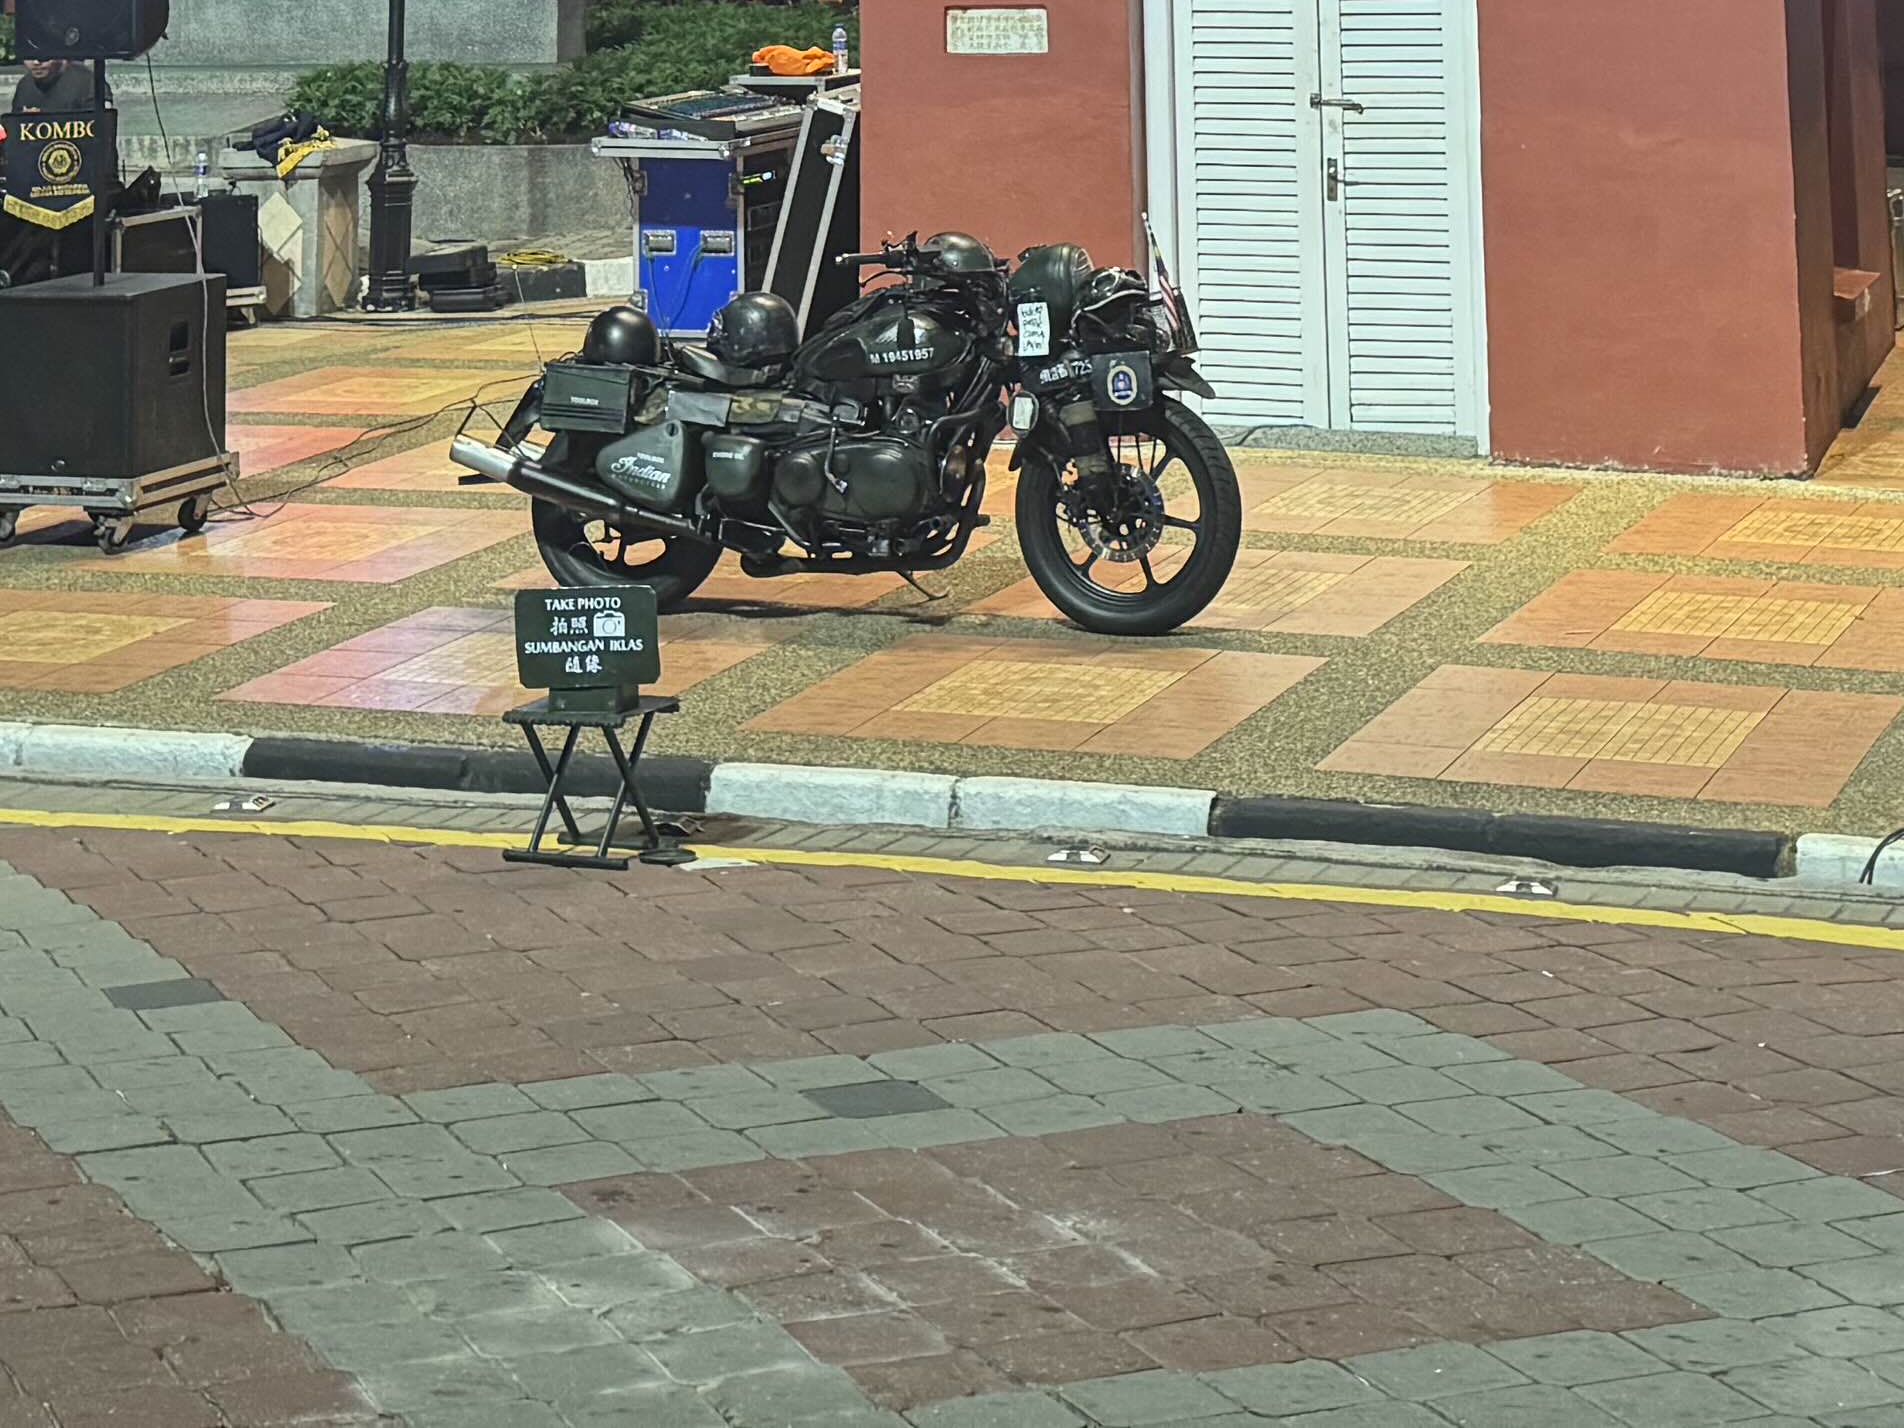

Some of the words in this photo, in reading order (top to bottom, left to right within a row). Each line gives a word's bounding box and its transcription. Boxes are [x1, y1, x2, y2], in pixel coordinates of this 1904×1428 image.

[869, 353, 881, 364] M
[882, 347, 935, 363] 19451957
[610, 456, 672, 483] Indian
[544, 598, 576, 611] TAKE
[577, 596, 621, 610] PHOTO
[549, 616, 589, 636] 拍照
[524, 639, 605, 654] SUMBANGAN
[609, 638, 644, 652] IKLAS
